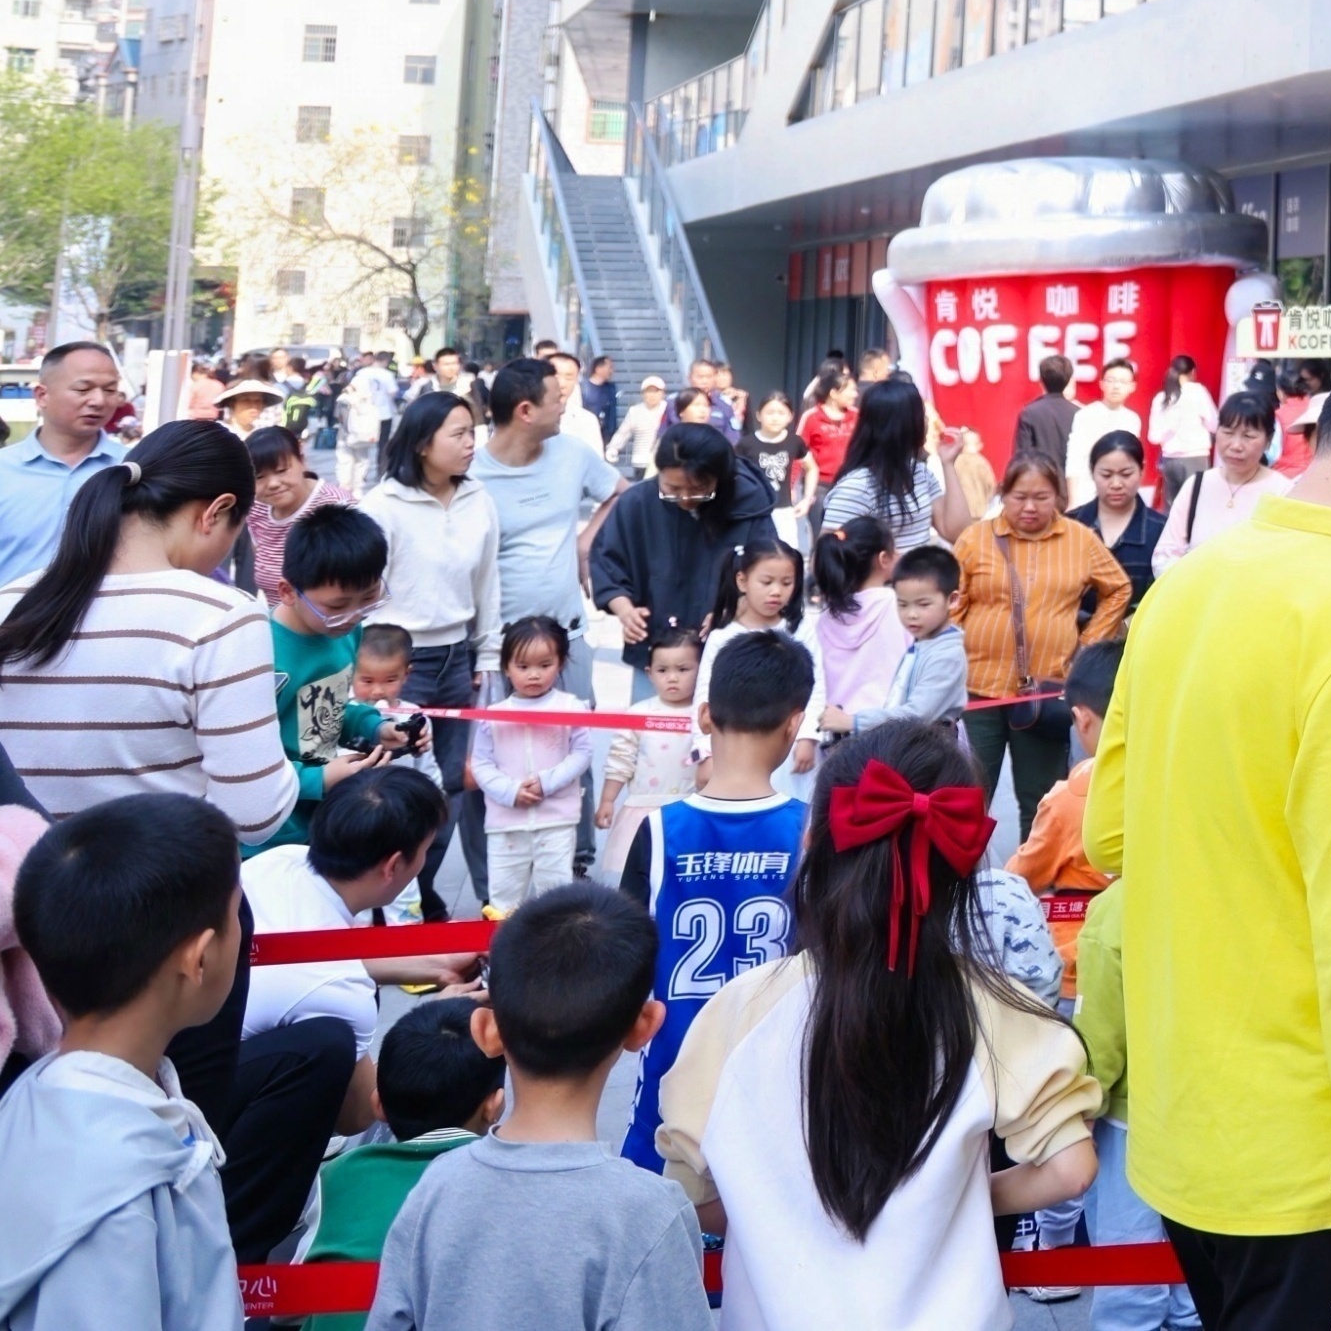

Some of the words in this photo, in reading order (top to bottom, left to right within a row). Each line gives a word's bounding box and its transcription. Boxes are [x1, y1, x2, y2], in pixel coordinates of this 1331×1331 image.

[675, 850, 791, 877] 玉锋体育
[677, 874, 725, 883] YUFENG
[667, 895, 791, 1001] 23
